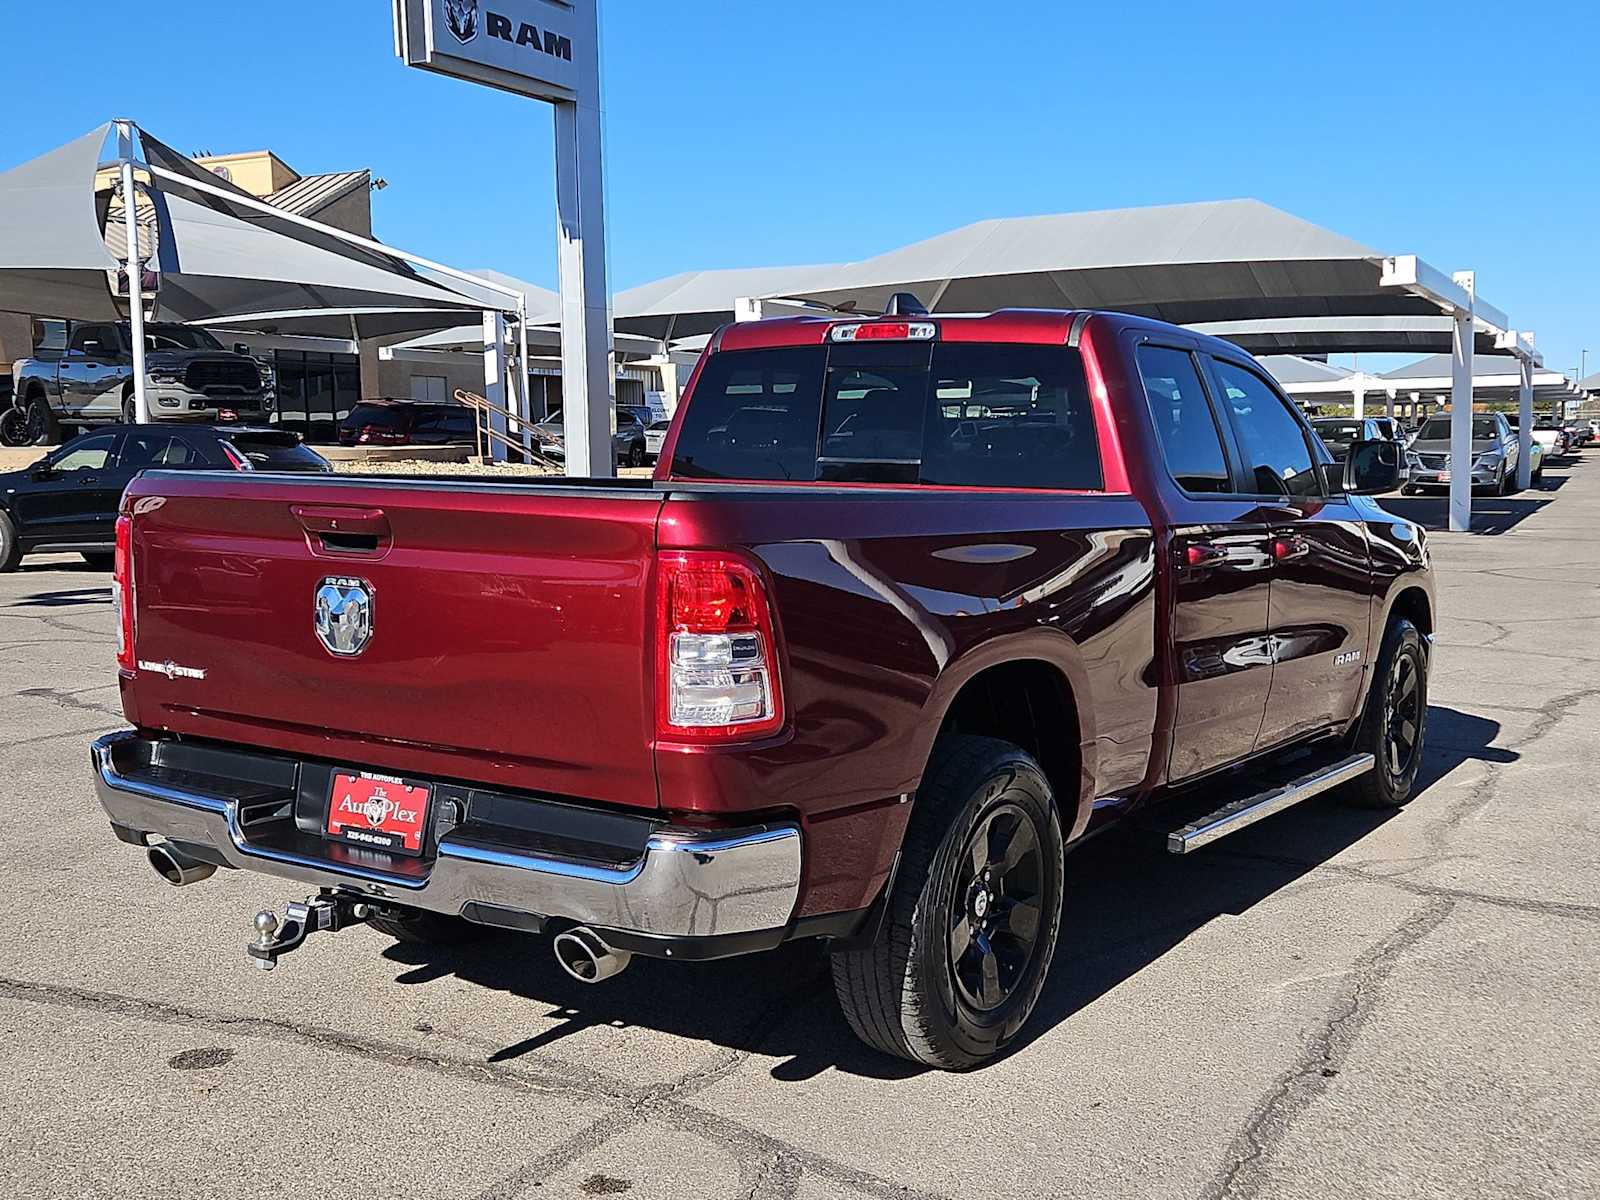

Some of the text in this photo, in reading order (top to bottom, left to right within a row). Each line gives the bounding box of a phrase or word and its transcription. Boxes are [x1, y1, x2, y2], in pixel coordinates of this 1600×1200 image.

[486, 11, 572, 62] RAM
[325, 577, 361, 587] RAM
[1335, 651, 1361, 665] RAM
[138, 660, 208, 680] LONE STAR
[360, 771, 403, 785] THE AUTOPLEX
[374, 786, 388, 796] The
[338, 794, 417, 823] AutoPlex
